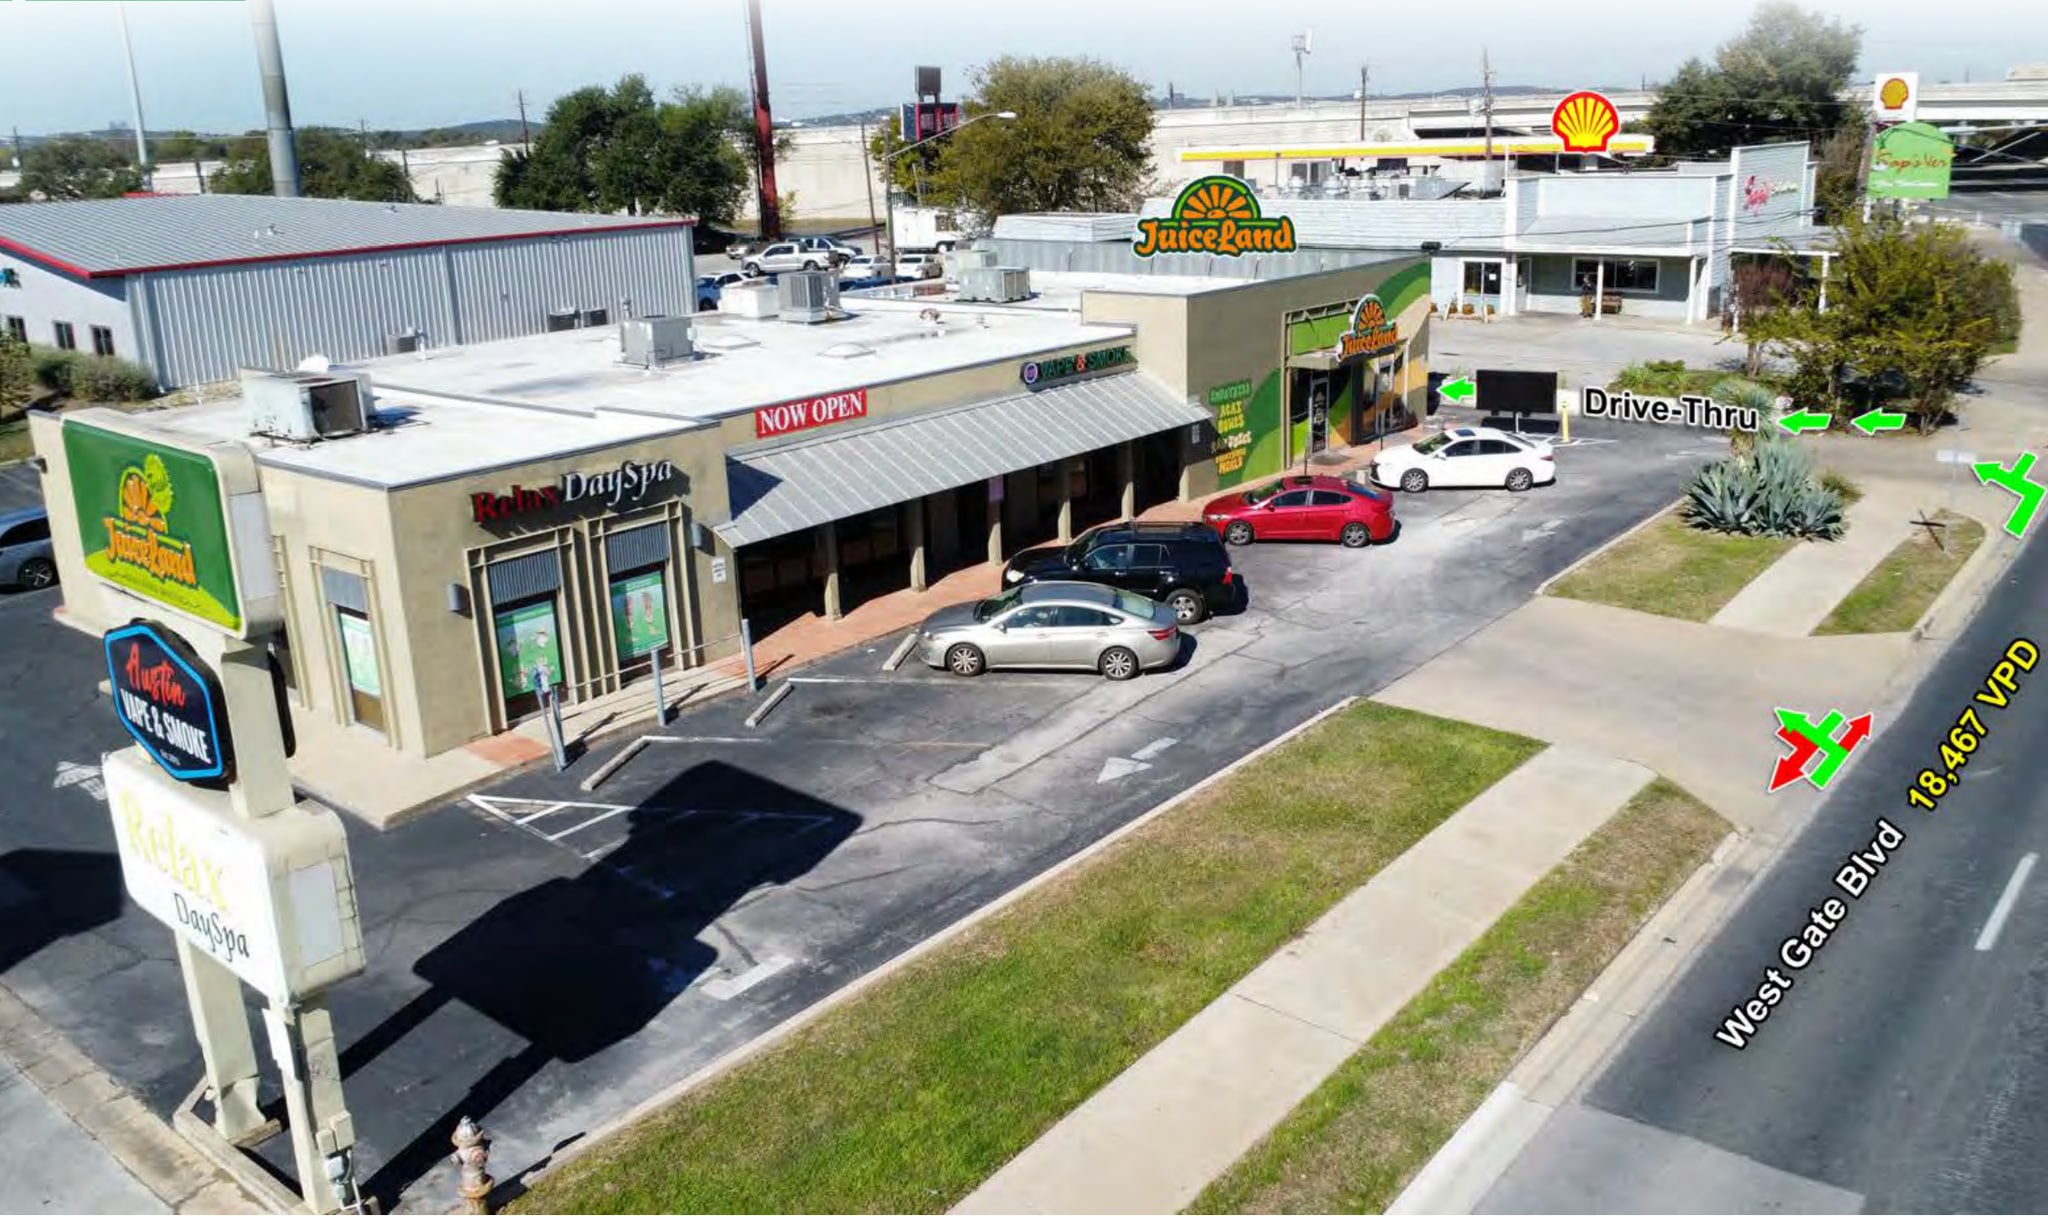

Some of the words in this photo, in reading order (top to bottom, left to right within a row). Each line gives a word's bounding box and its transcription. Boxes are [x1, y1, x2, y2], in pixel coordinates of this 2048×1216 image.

[1039, 355, 1074, 377] VAPE
[1075, 352, 1086, 373] &
[1339, 322, 1398, 361] JuiceLand
[759, 402, 808, 434] NOW
[812, 391, 862, 423] OPEN
[564, 459, 673, 507] DaySpa
[103, 516, 197, 587] JuiceLand
[126, 642, 186, 708] Austin
[120, 687, 154, 733] VAPE
[151, 705, 165, 740] &
[162, 711, 212, 765] SMOKE
[120, 789, 229, 914] Relax
[174, 893, 250, 963] DaySpa
